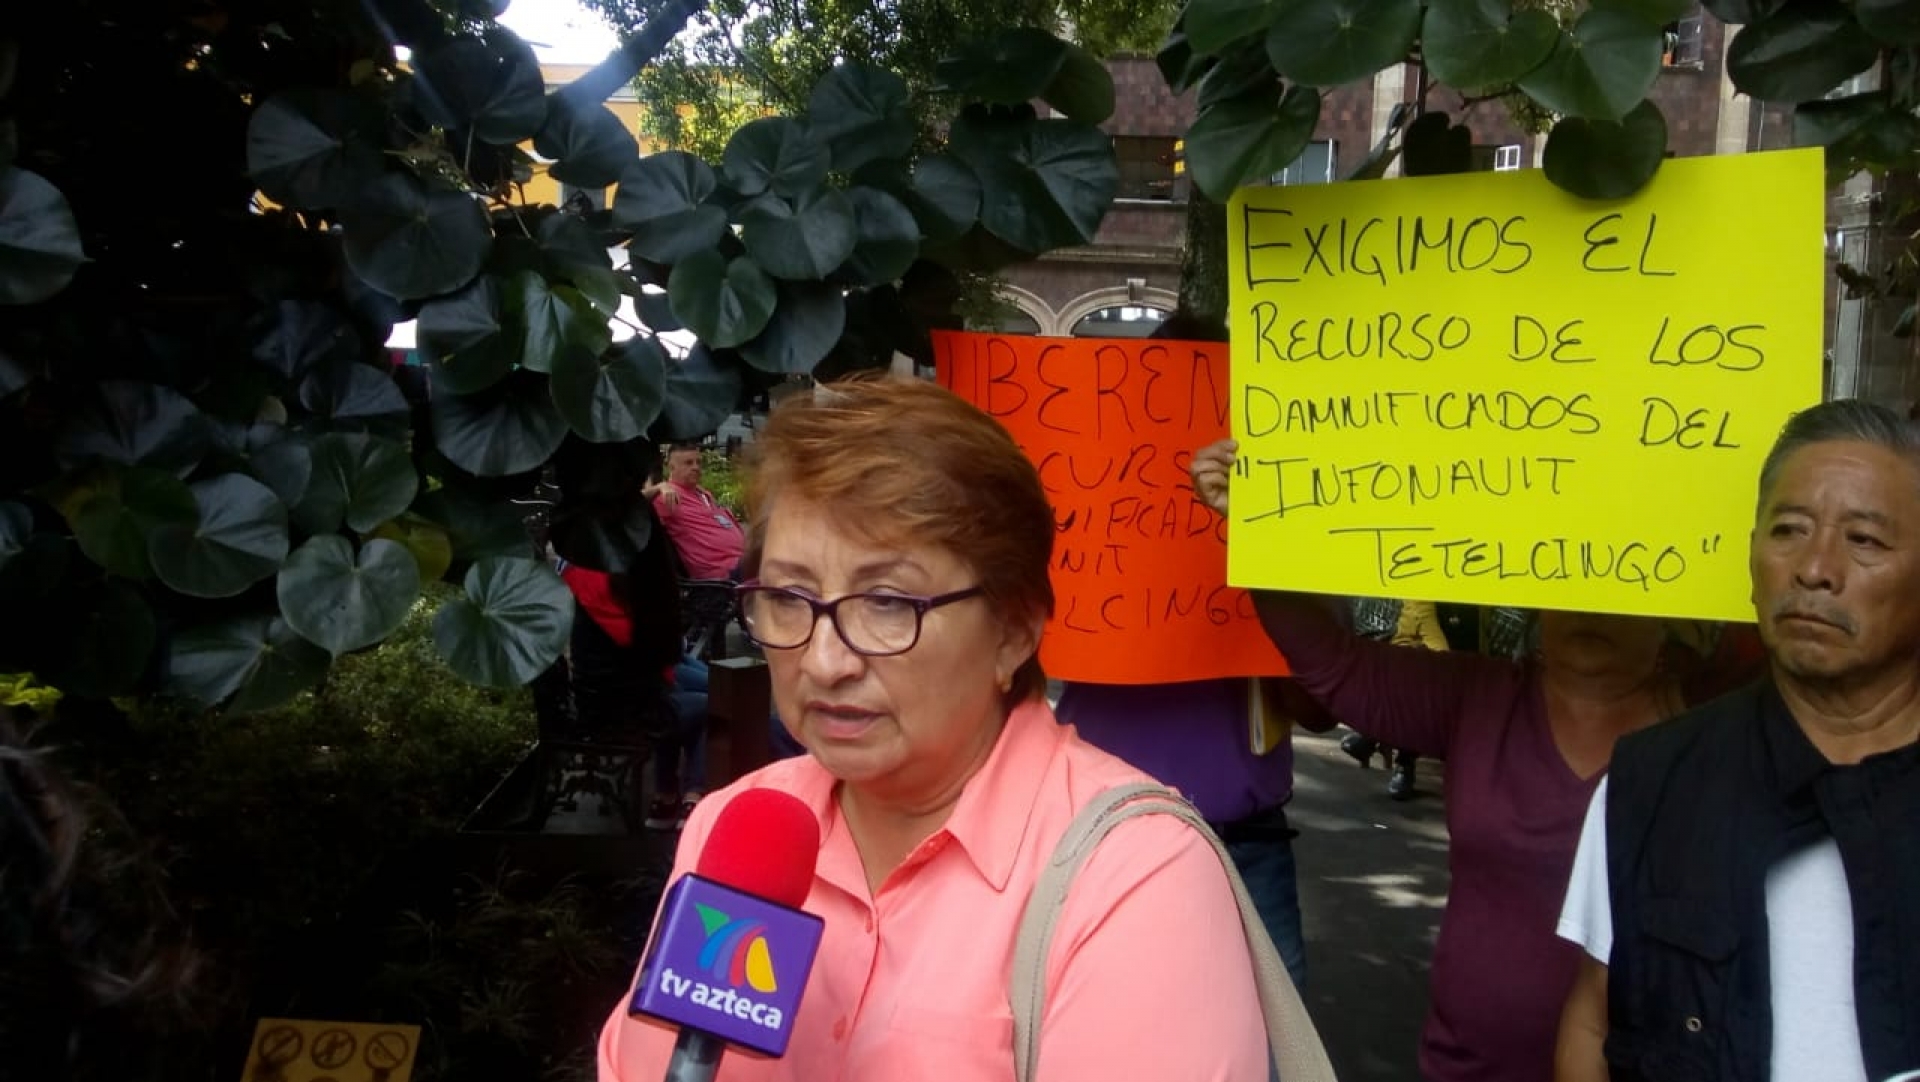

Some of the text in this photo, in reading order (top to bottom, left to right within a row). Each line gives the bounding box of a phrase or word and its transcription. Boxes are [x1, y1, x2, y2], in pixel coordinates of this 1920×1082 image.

[1244, 204, 1677, 290] EXIGIMOS EL
[1250, 302, 1766, 371] RECURSO DE LOS
[1244, 384, 1740, 449] DAMNIFICADOS DEL
[1038, 444, 1195, 493] CURS
[660, 967, 782, 1029] tv azteca
